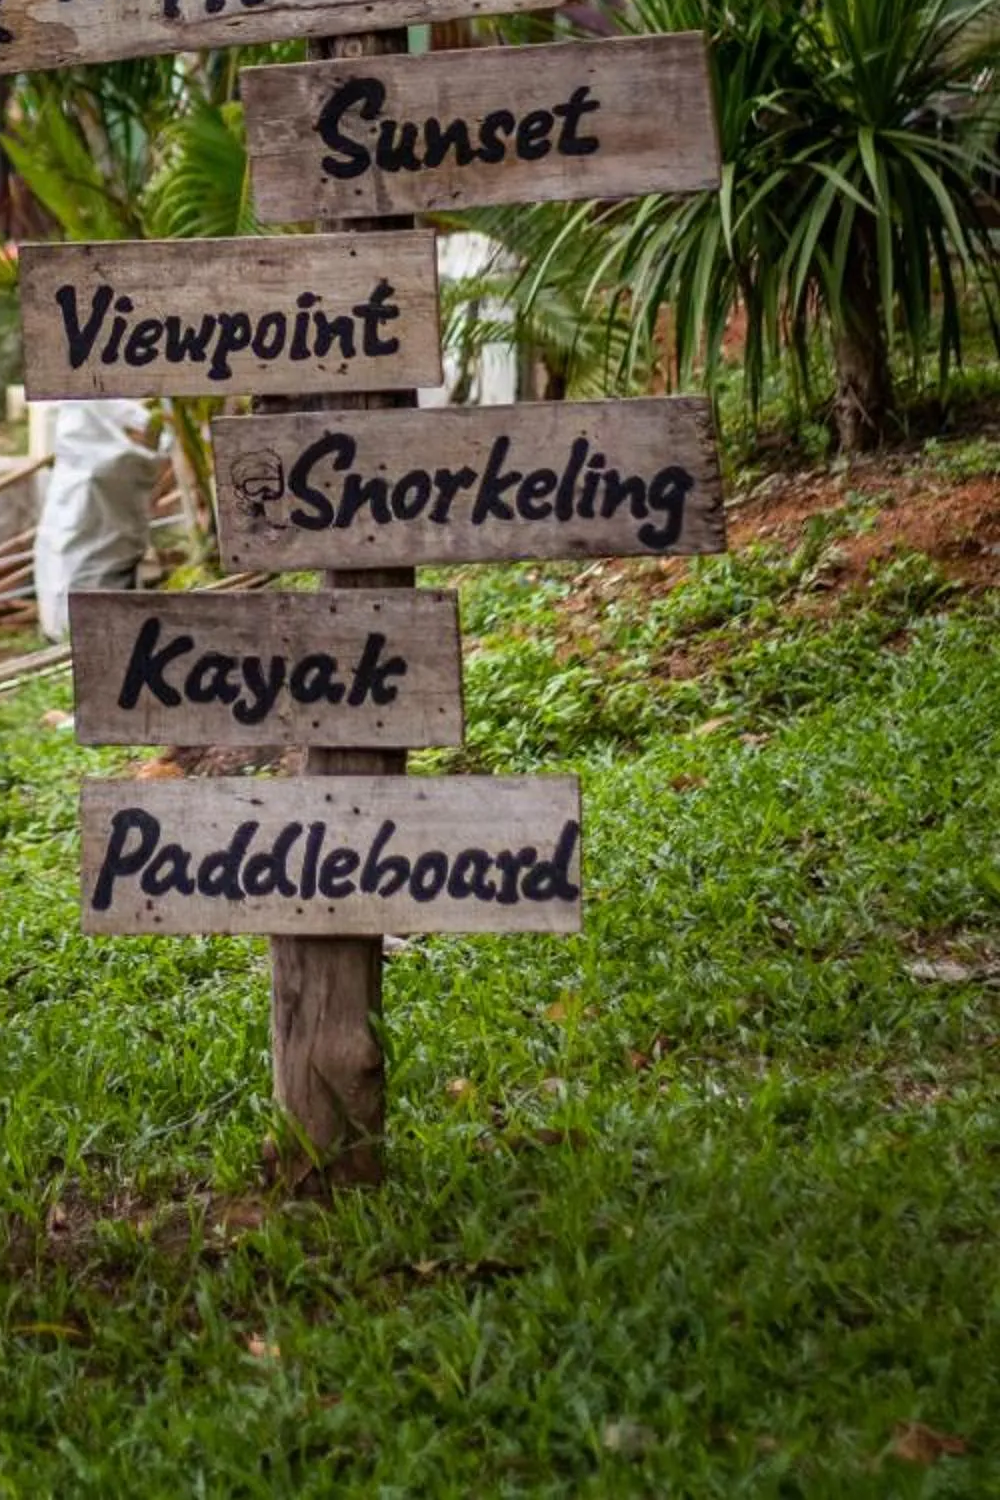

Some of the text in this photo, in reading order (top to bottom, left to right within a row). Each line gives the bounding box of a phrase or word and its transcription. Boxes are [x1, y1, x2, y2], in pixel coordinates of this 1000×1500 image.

[316, 77, 600, 179] Sunset
[56, 279, 400, 380] Viewpoint
[288, 433, 694, 548] Snorkeling
[118, 618, 407, 724] Kayak
[92, 807, 579, 911] Paddleboard
